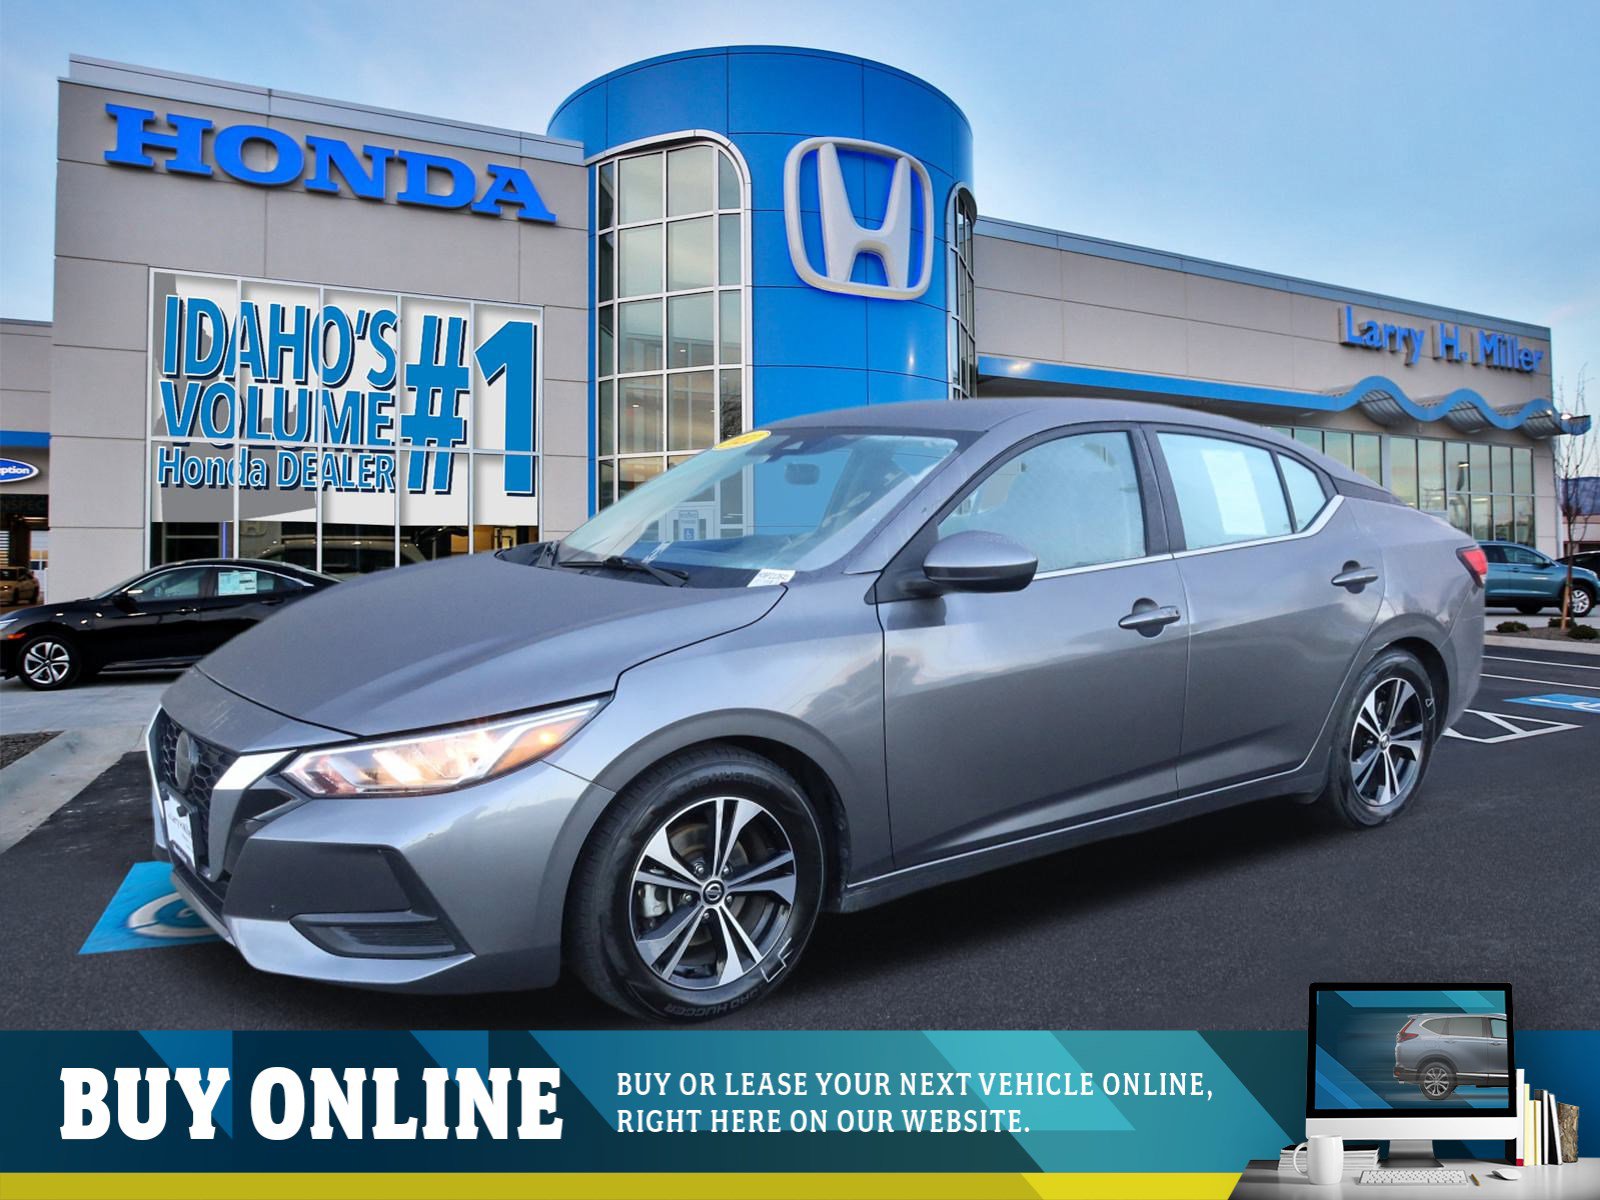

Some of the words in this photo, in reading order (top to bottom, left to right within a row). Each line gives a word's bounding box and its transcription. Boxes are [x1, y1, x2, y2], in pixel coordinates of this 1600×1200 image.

[105, 103, 558, 224] HONDA
[163, 294, 398, 391] IDAHO'S
[1340, 306, 1425, 366] Larry
[1433, 323, 1468, 362] H.
[1471, 330, 1544, 374] Miller
[159, 379, 397, 452] VOLUME
[400, 314, 538, 496] #1
[0, 465, 31, 476] ption
[157, 446, 270, 490] Honda
[275, 450, 396, 493] DEALER
